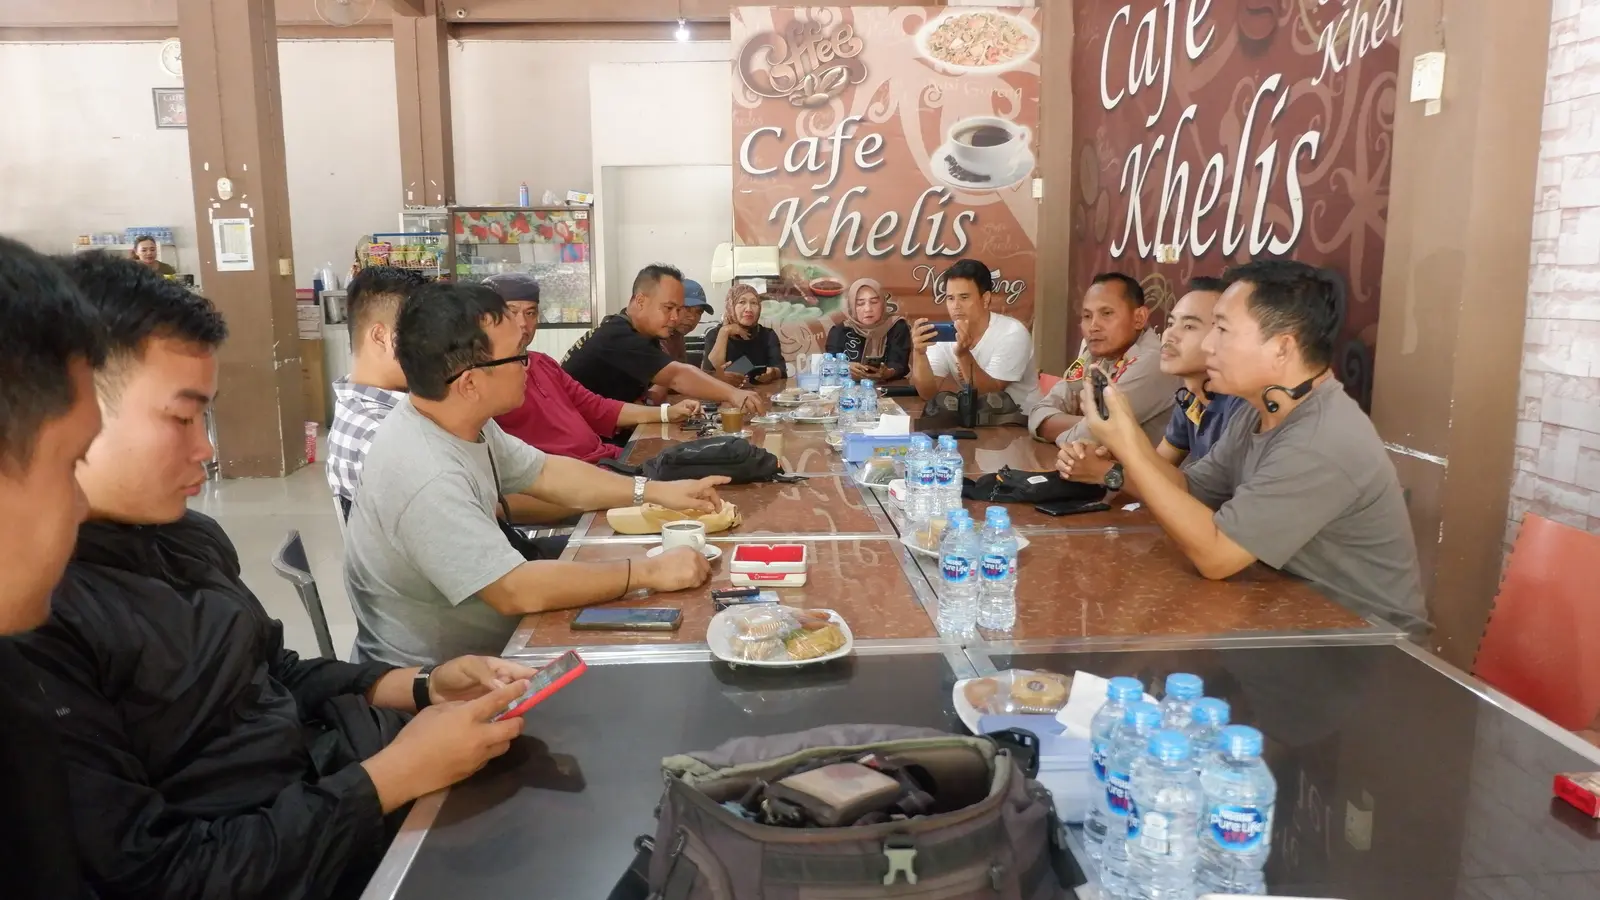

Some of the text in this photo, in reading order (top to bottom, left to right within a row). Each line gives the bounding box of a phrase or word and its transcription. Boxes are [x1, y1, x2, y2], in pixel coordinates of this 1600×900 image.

[1100, 0, 1214, 128] Cafe
[739, 115, 885, 190] Cafe
[1109, 73, 1321, 259] Khelis
[768, 186, 976, 259] Khelis
